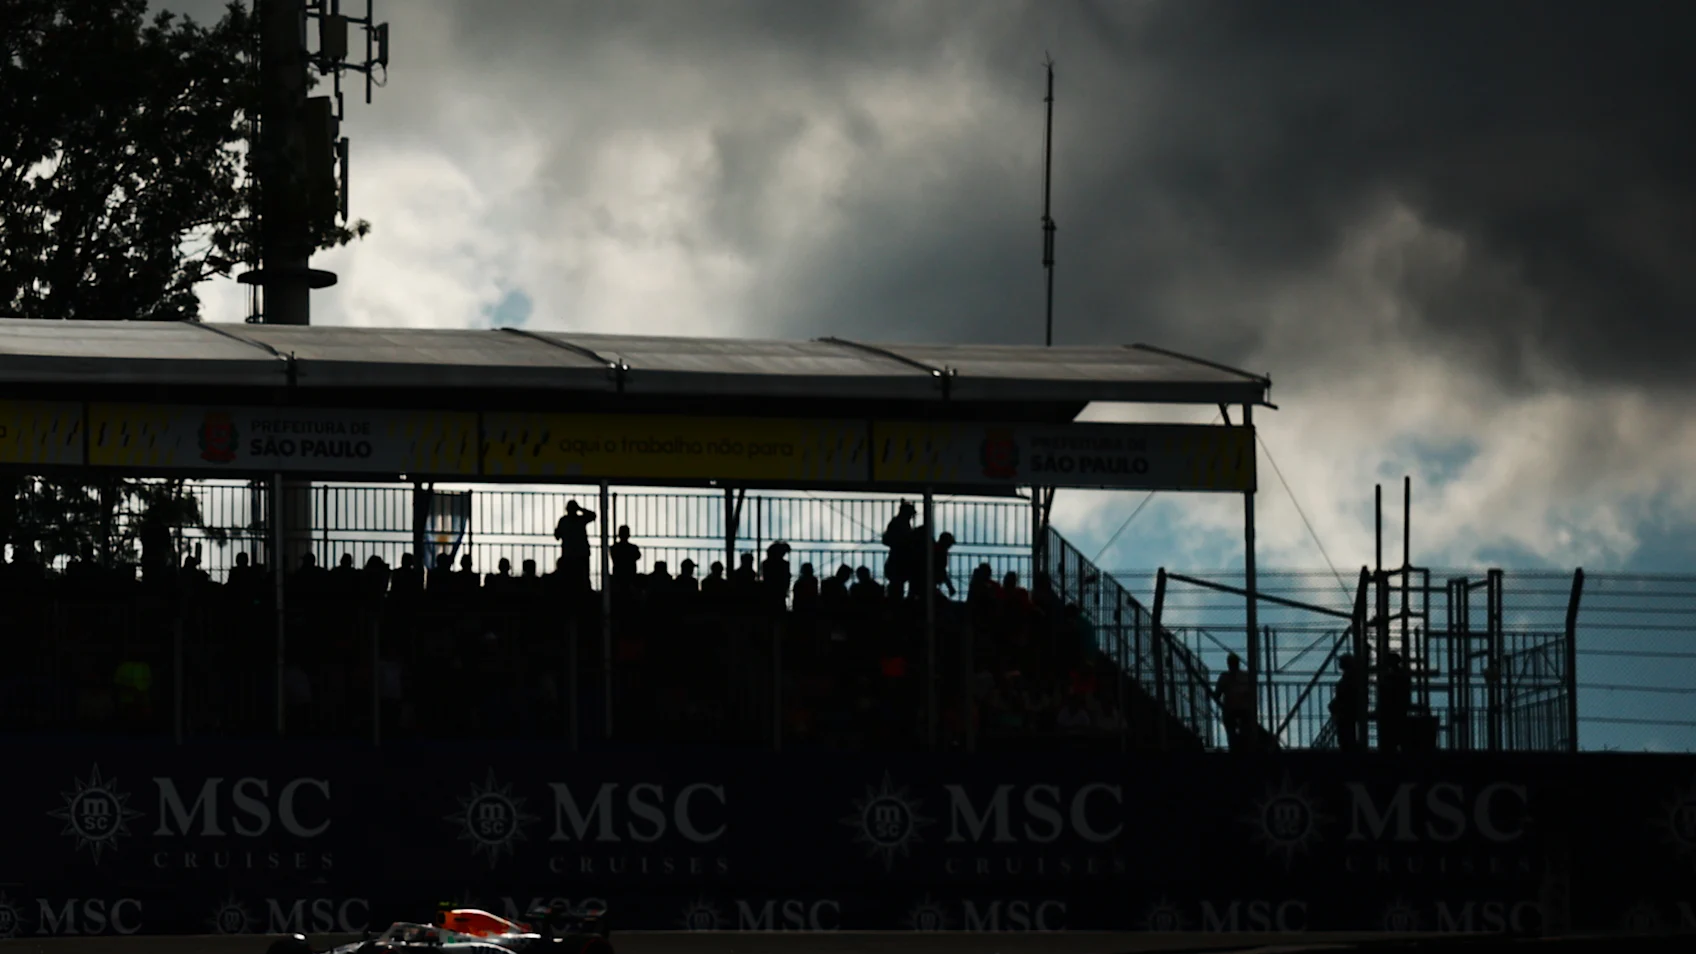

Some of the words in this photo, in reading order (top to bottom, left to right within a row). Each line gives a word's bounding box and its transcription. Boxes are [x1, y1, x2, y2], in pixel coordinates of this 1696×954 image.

[251, 419, 346, 434] PREFEITURA
[350, 421, 371, 436] DE
[250, 434, 296, 457] SÃO
[300, 439, 373, 458] PAULO
[559, 435, 601, 457] aqui
[604, 439, 616, 453] o
[621, 435, 703, 455] trabalho
[706, 438, 743, 456] não
[747, 441, 794, 460] para
[1079, 455, 1149, 475] PAULO
[152, 776, 331, 838] MSC
[547, 782, 727, 843] MSC
[943, 783, 1124, 843] MSC
[1345, 781, 1528, 842] MSC
[153, 851, 334, 869] CRUISES
[548, 856, 729, 874] CRUISES
[35, 898, 143, 934] MSC
[266, 897, 370, 934] MSC
[737, 899, 840, 931] MSC
[962, 899, 1067, 931] MSC
[1200, 900, 1307, 933] MSC
[1434, 900, 1543, 933] MSC
